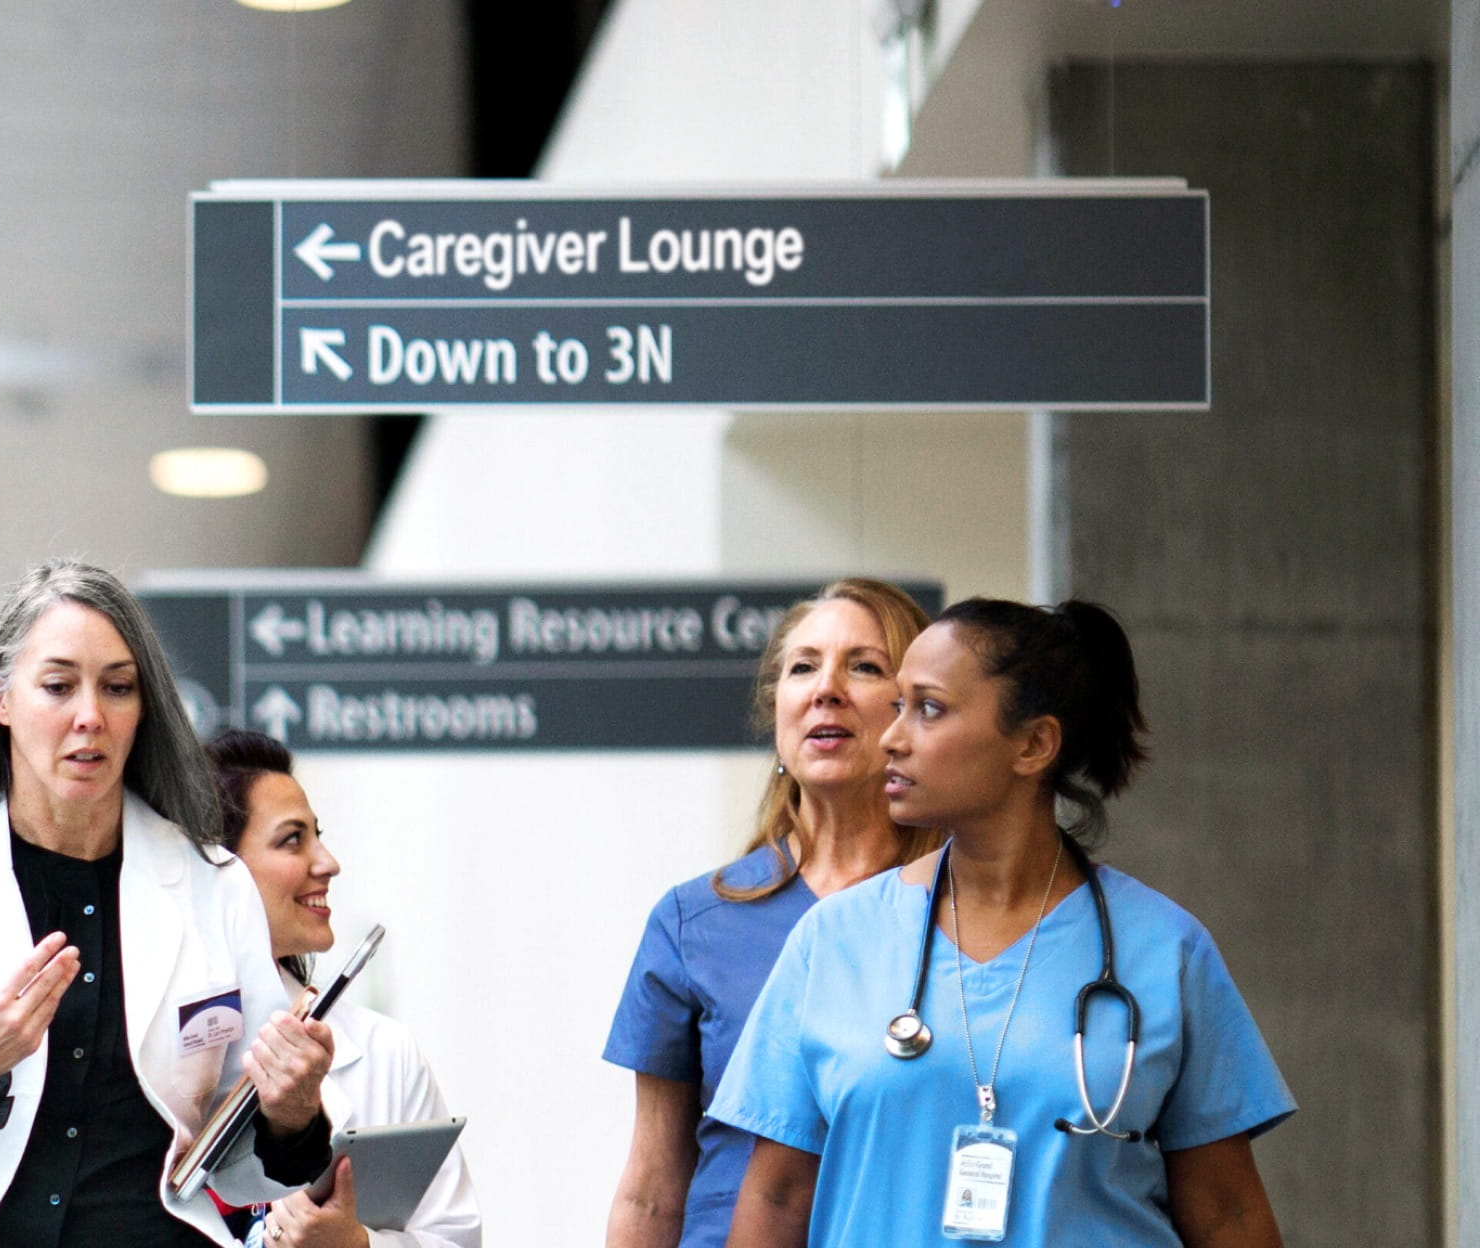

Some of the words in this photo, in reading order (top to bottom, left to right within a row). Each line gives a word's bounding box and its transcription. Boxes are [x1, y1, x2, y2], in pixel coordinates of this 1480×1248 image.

[368, 218, 607, 291] Caregiver
[618, 216, 804, 286] Lounge
[367, 324, 517, 386] Down
[532, 330, 589, 385] to
[605, 325, 673, 384] 3N
[308, 600, 499, 663] Learning
[510, 601, 703, 652] Resource
[308, 684, 537, 740] Restrooms
